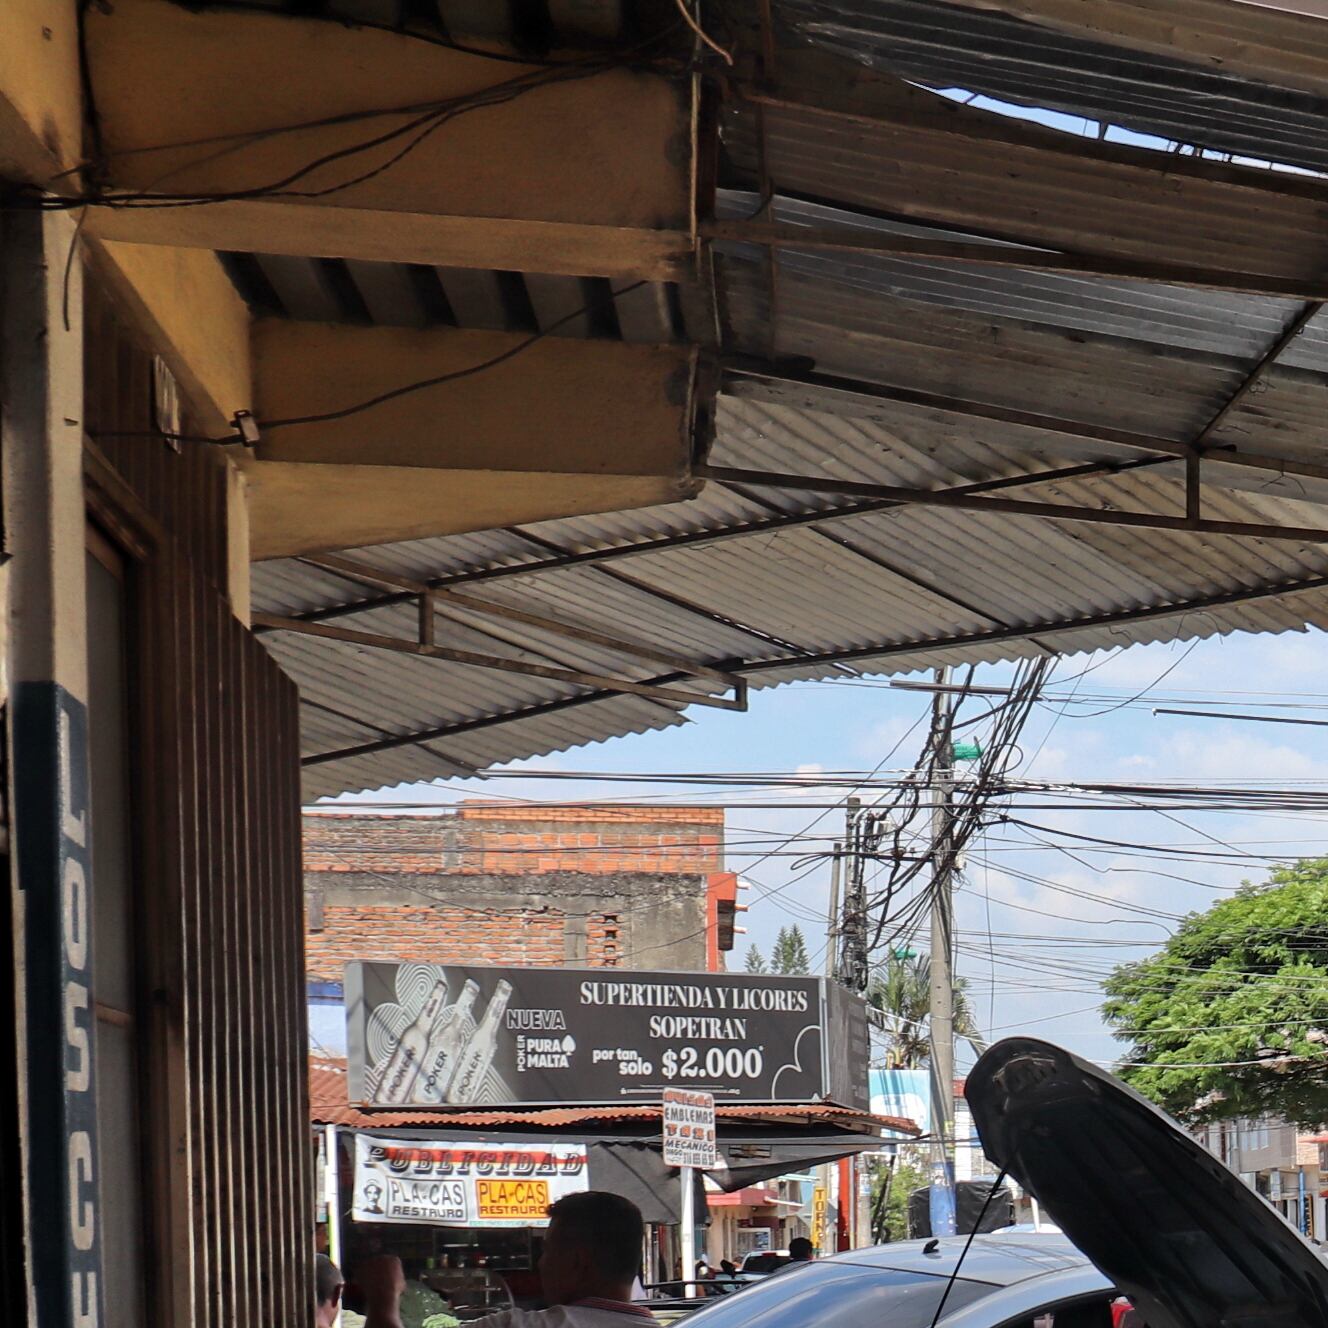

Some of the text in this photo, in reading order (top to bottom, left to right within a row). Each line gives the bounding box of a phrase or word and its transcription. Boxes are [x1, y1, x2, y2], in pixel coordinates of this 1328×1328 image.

[59, 706, 90, 1093] LOS
[580, 981, 808, 1012] SUPERTIENDA Y LICORES
[506, 1008, 567, 1030] NUEVA
[649, 1015, 747, 1040] SOPETRAN
[517, 1034, 526, 1072] POKER
[527, 1038, 561, 1053] PURA
[593, 1049, 638, 1063] por tan
[389, 1046, 416, 1096] POKER
[527, 1053, 570, 1068] MALTA
[619, 1058, 652, 1075] solo
[424, 1050, 449, 1095] POKER
[457, 1052, 482, 1096] POKER
[665, 1107, 713, 1125] EMBLEMAS
[665, 1139, 713, 1153] MECANICO
[364, 1144, 582, 1177] PUBLICIDAD
[391, 1205, 464, 1219] RESTAURO
[480, 1205, 546, 1215] RESTAURO
